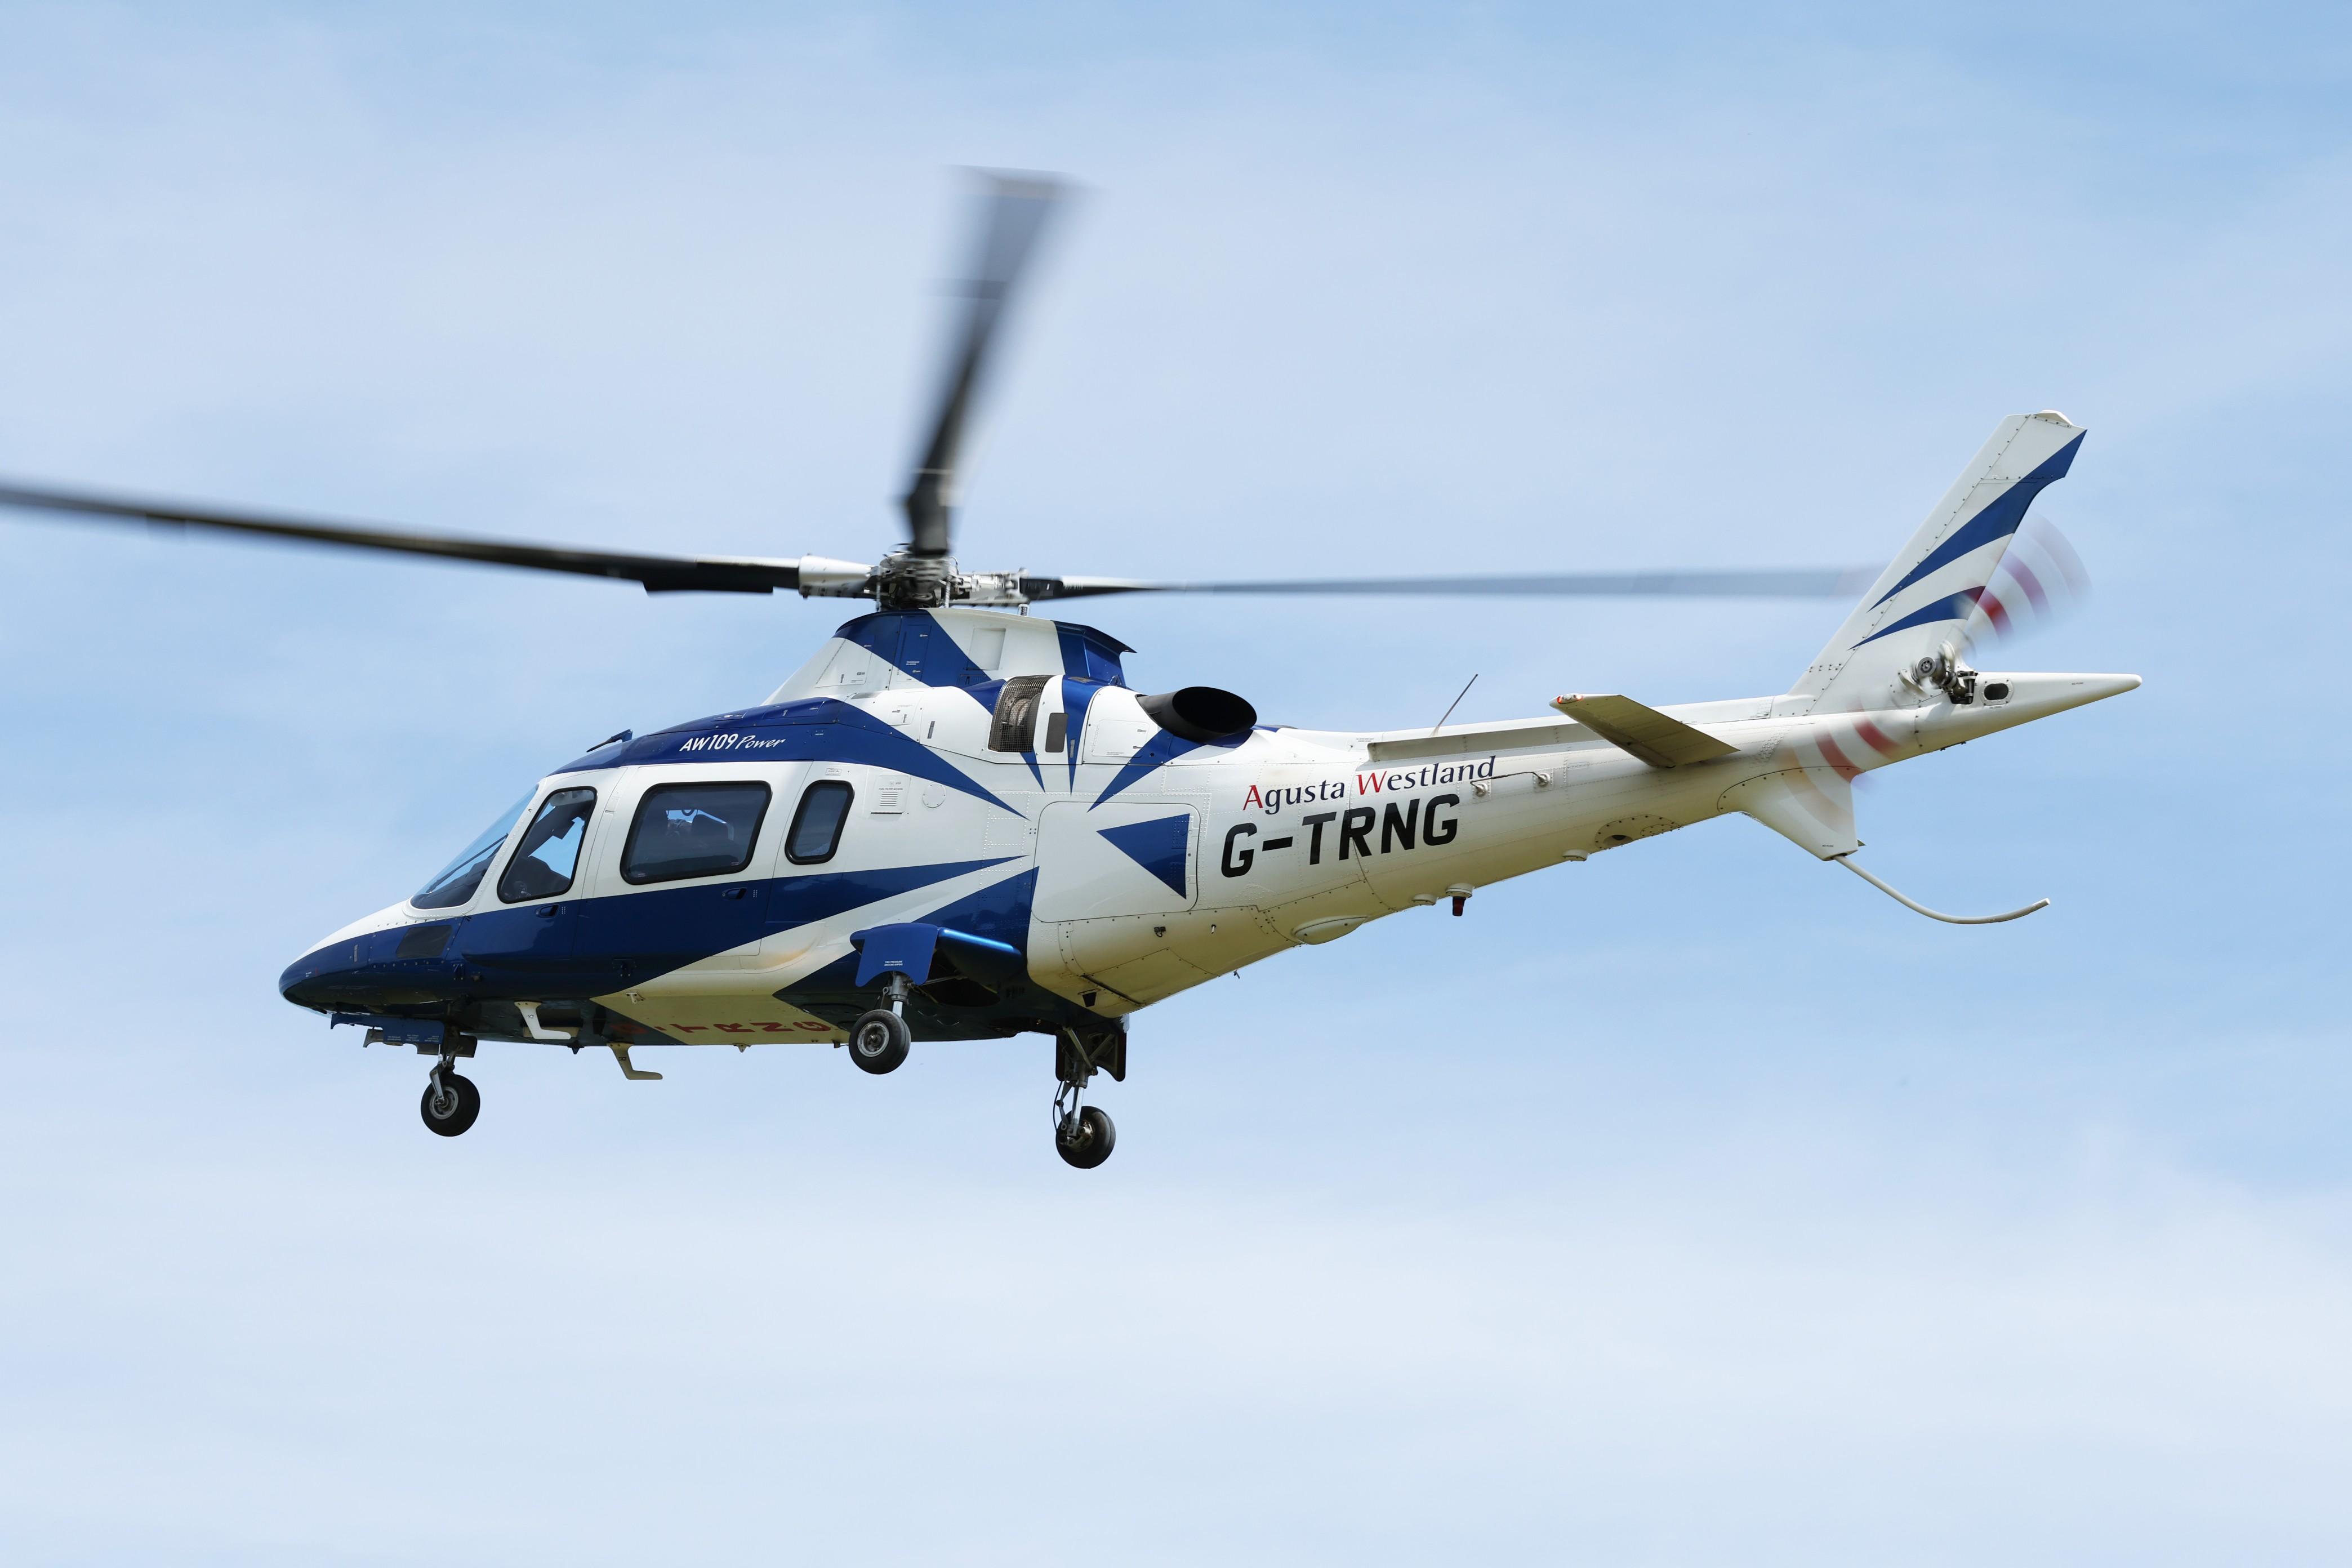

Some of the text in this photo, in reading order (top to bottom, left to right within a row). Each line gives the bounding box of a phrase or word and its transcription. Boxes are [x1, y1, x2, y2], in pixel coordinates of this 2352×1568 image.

[679, 733, 786, 751] AW109 Power
[1243, 755, 1496, 815] Agusta Westland
[1221, 794, 1460, 878] G-TRNG
